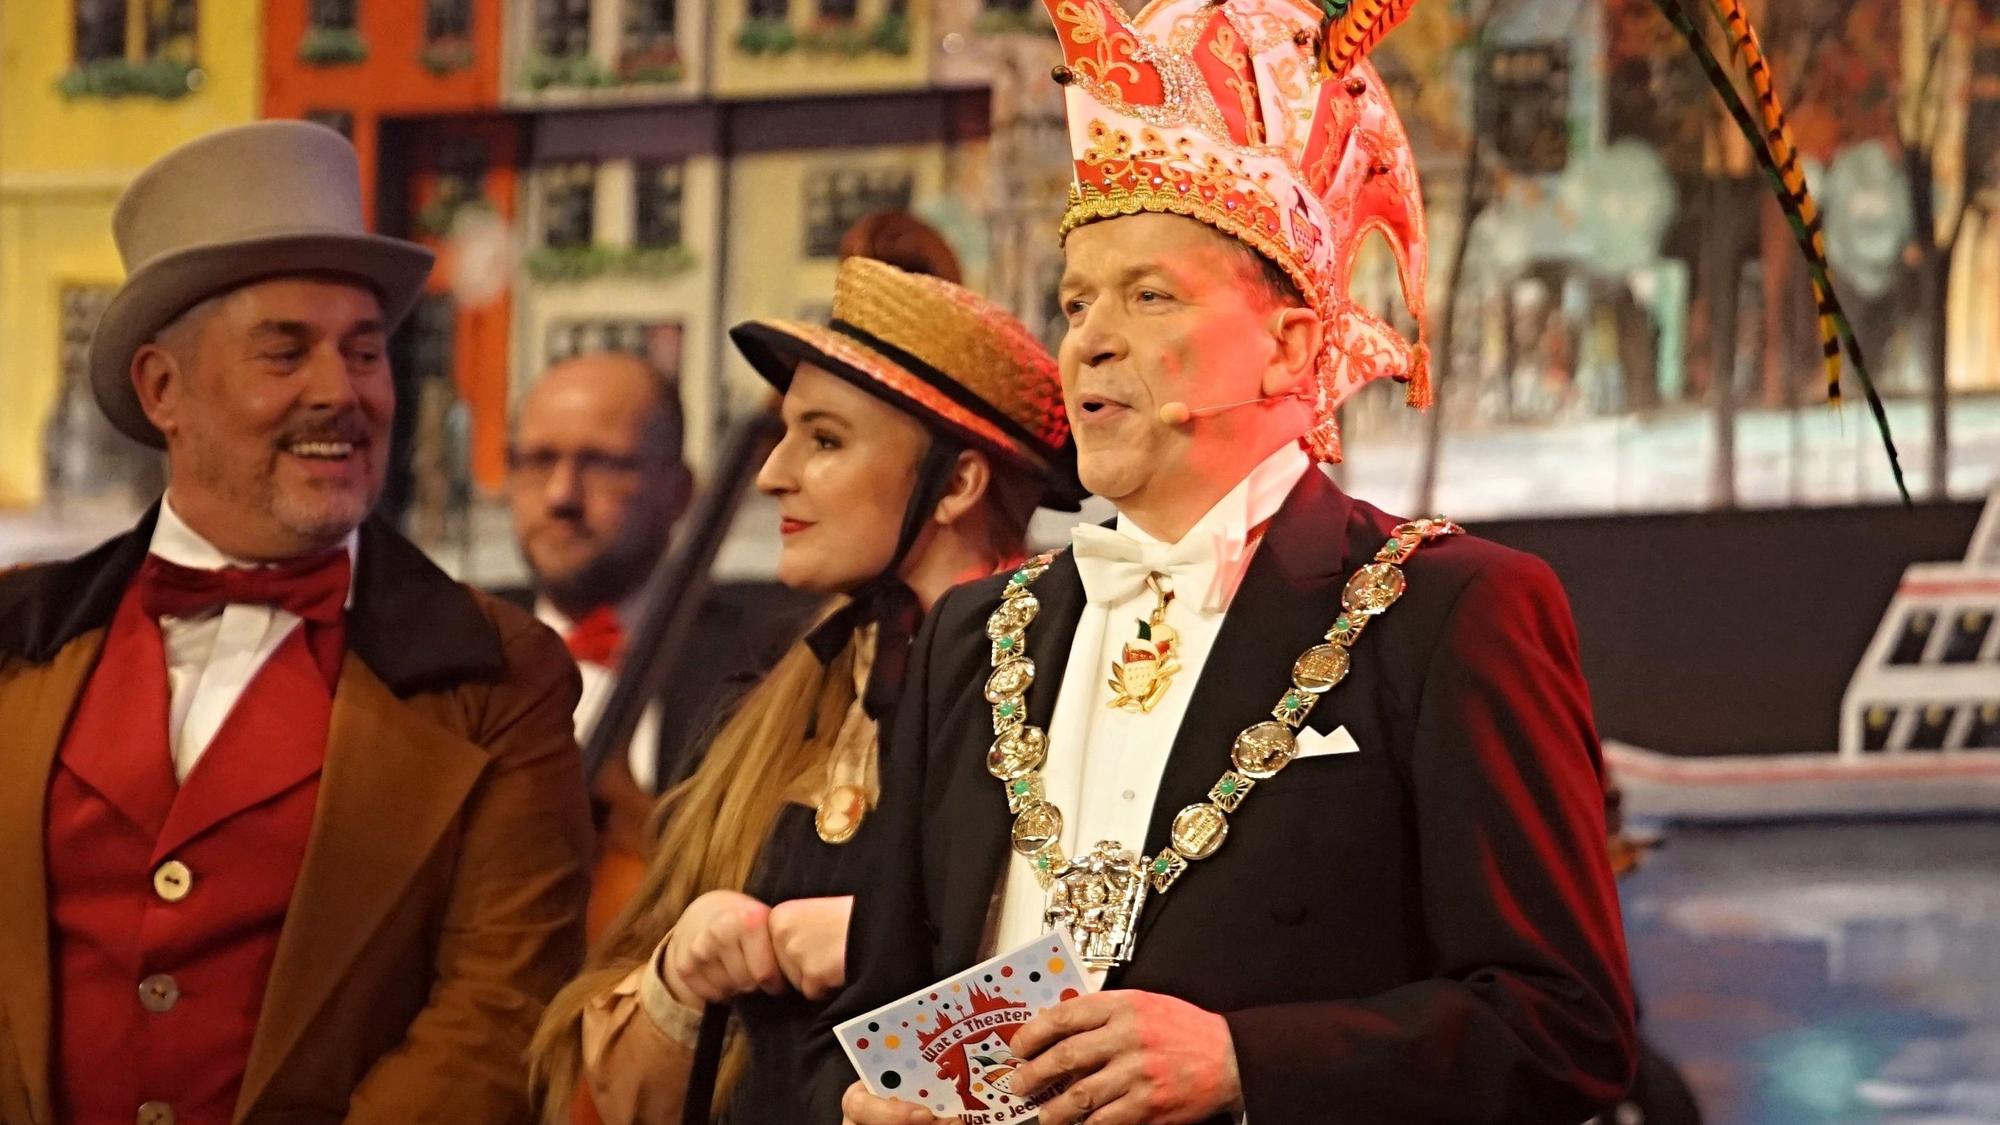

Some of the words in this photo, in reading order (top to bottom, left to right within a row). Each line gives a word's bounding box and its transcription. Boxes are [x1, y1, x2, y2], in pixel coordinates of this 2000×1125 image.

[921, 1037, 951, 1062] Wat
[952, 1028, 963, 1039] e
[963, 1010, 1032, 1032] Theater
[994, 1111, 1005, 1121] e
